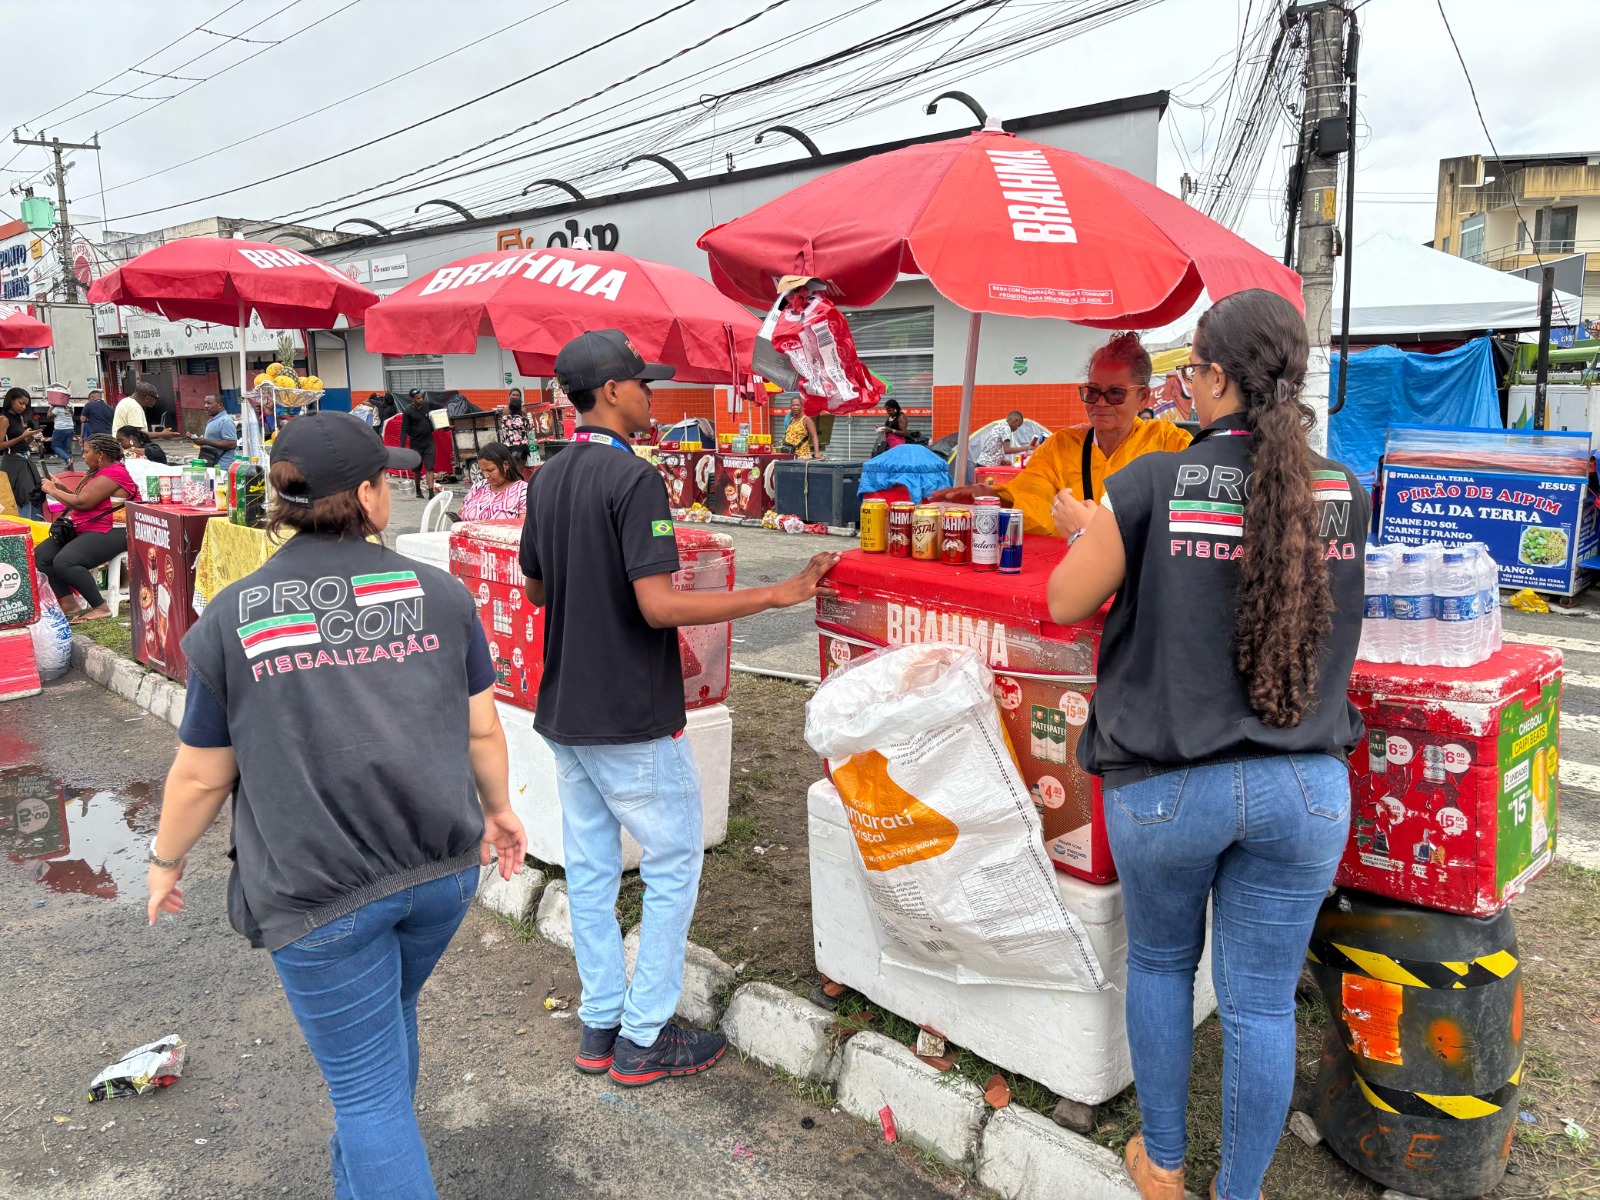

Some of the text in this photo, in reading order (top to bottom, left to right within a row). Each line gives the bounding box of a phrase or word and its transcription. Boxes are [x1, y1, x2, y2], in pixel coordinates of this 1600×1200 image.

[986, 150, 1078, 243] BRAHMA
[418, 252, 628, 301] BRAHMA
[1174, 464, 1254, 501] PR
[1537, 482, 1576, 491] JESUS
[1397, 483, 1562, 515] PIRÃO DE AIPIM
[1411, 502, 1542, 523] SAL DA TERRA
[1423, 519, 1438, 527] DO
[1438, 521, 1459, 529] SOL
[1430, 530, 1473, 540] FRANGO
[1497, 564, 1535, 575] RANGO
[0, 601, 24, 612] ABOR
[238, 576, 348, 623] PRO
[320, 598, 424, 645] CON
[887, 602, 1009, 668] BRAHMA
[251, 634, 440, 682] FISCALIZAÇÃO
[1519, 713, 1543, 736] CHEGOU
[1514, 726, 1546, 755] CAIPI BEATS
[916, 838, 939, 851] SUGAR
